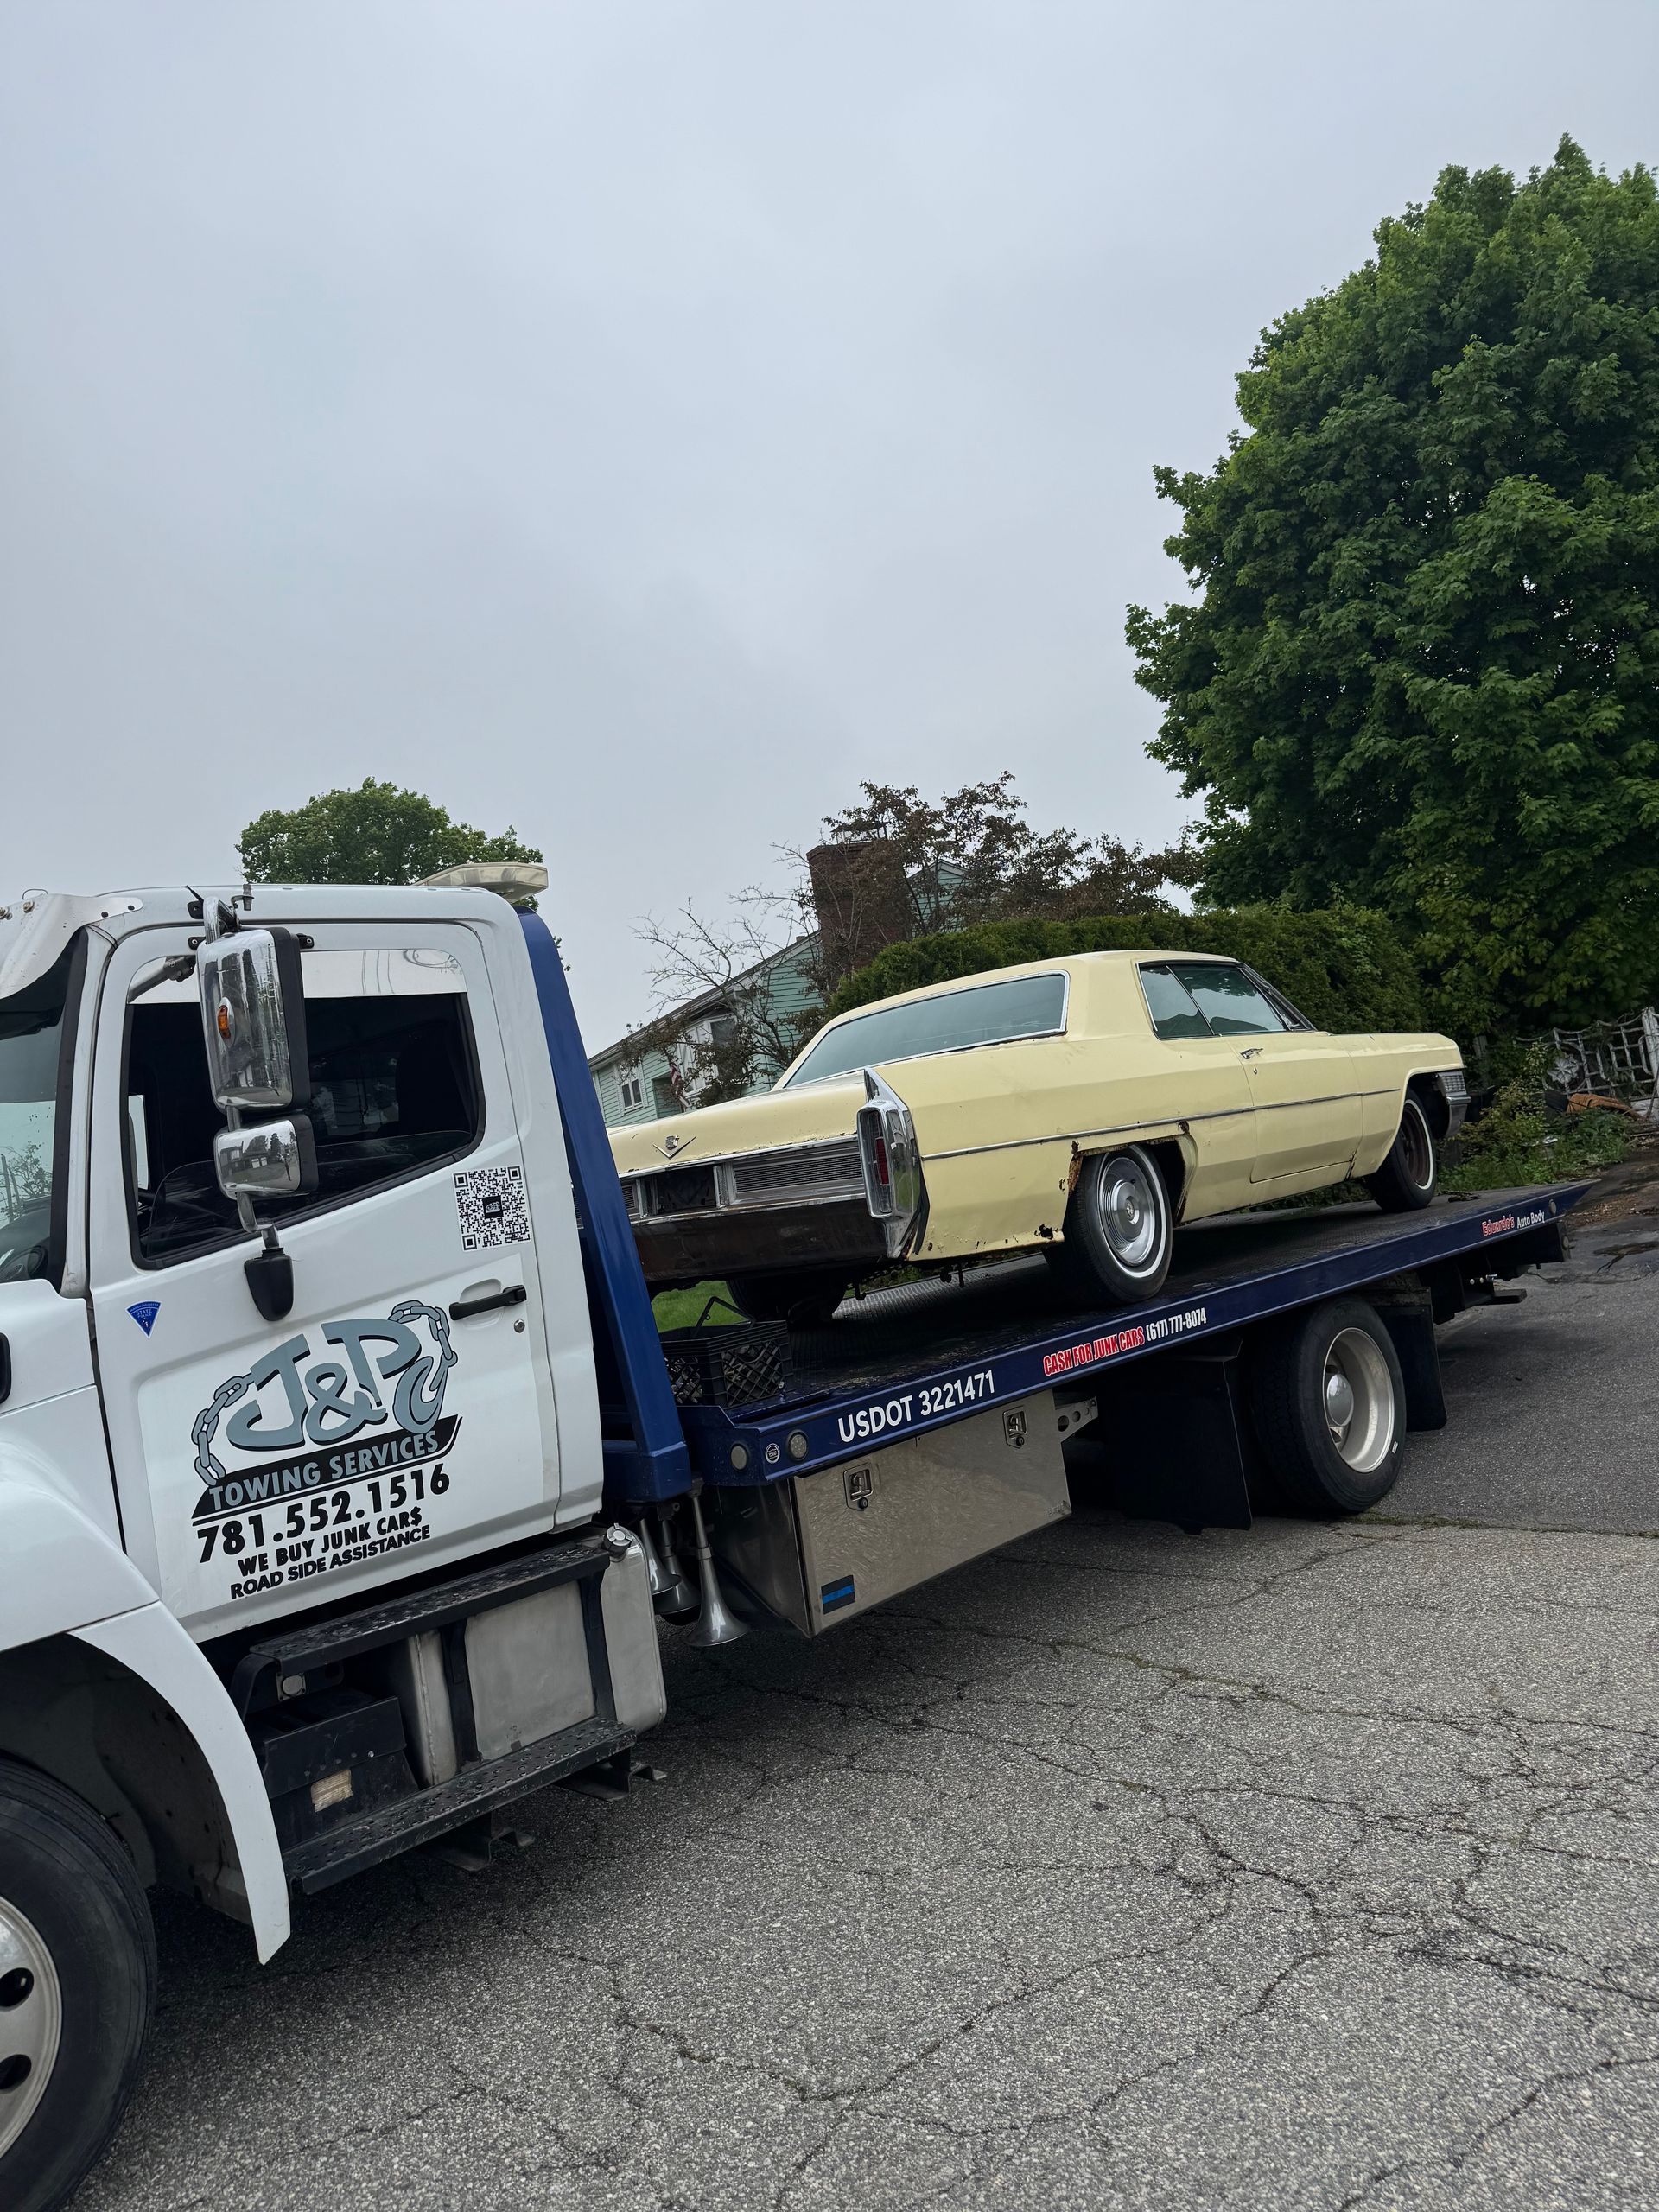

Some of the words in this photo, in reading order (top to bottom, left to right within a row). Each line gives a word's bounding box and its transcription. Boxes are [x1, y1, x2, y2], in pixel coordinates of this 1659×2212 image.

[1516, 1216, 1531, 1229] Auto
[1530, 1210, 1545, 1224] Body
[1043, 1349, 1073, 1376] CASH
[1072, 1341, 1094, 1367] FOR
[1093, 1333, 1120, 1361] JUNK
[1119, 1326, 1146, 1351] CARS
[1146, 1319, 1168, 1342] (617)
[1168, 1307, 1207, 1335] 777-8074
[838, 1395, 913, 1443] USDOT
[918, 1369, 995, 1416] 3221471
[208, 1461, 321, 1510] TOWING
[330, 1430, 439, 1480] SERVICES
[197, 1463, 450, 1563] 781.552.1516
[238, 1553, 269, 1577] WE
[276, 1539, 315, 1567] BUY
[321, 1522, 372, 1553] JUNK
[230, 1571, 284, 1599] ROAD
[288, 1557, 327, 1581] SIDE
[329, 1524, 430, 1569] ASSISTANCE
